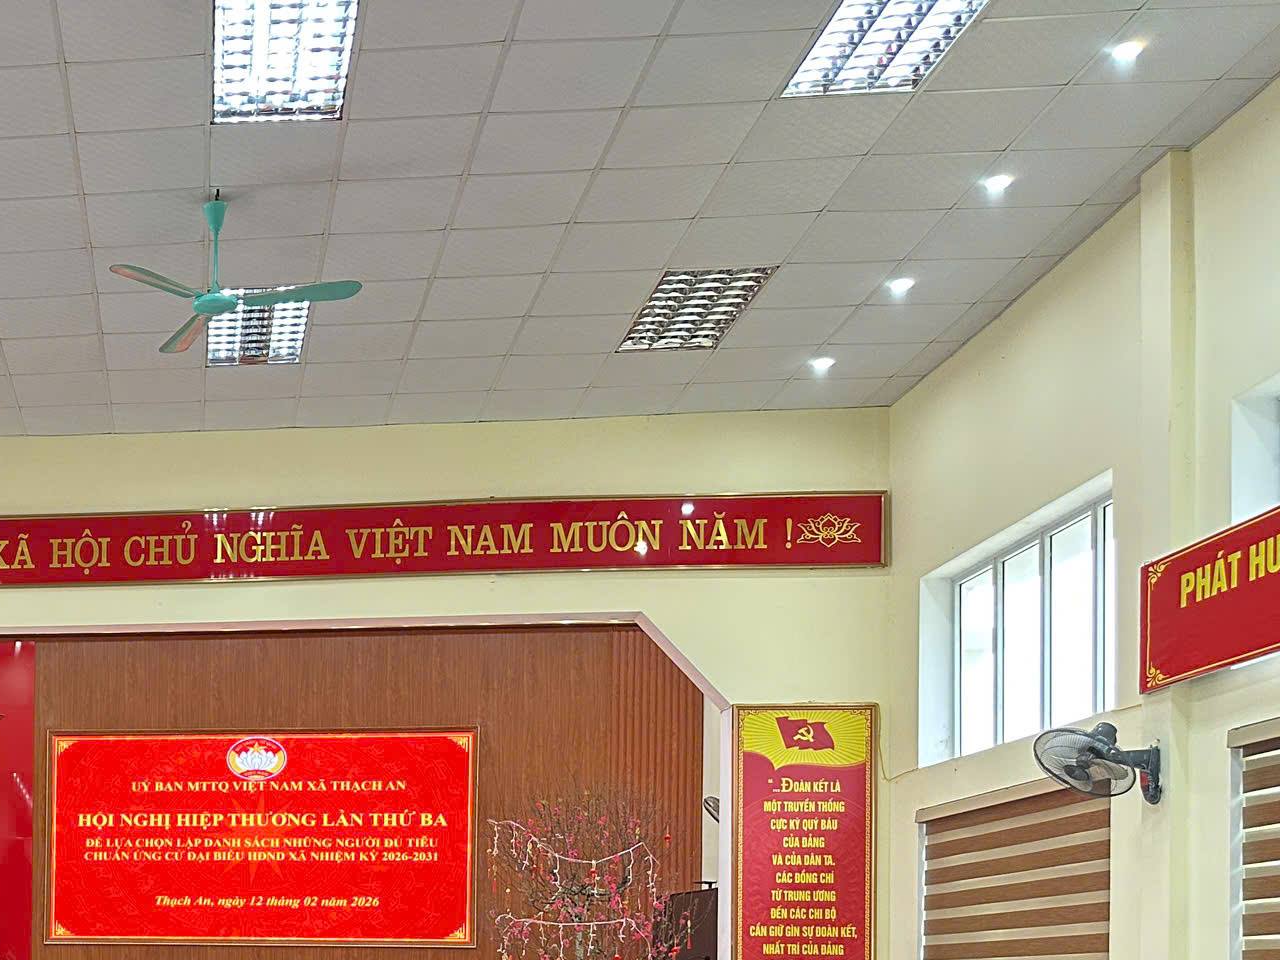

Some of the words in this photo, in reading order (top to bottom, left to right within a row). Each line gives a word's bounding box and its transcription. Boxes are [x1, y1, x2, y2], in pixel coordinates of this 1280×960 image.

[49, 529, 111, 576] HỘI
[124, 521, 199, 566] CHỦ
[213, 523, 330, 564] NGHĨA
[345, 518, 434, 566] VIỆT
[447, 523, 534, 556] NAM
[550, 512, 662, 554] MUÔN
[678, 512, 769, 552] NĂM
[1180, 549, 1241, 609] PHÁT
[155, 781, 183, 792] BAN
[187, 781, 230, 794] MTTQ
[232, 780, 266, 794] VIỆT
[271, 780, 301, 792] NAM
[307, 778, 326, 791] XÃ
[331, 780, 382, 793] THẠCH
[385, 780, 407, 791] AN
[831, 779, 841, 792] LÀ
[78, 811, 114, 831] HỘI
[120, 812, 170, 830] NGHỊ
[177, 811, 224, 830] HIỆP
[227, 811, 317, 827] THƯƠNG
[369, 808, 416, 827] THỨ
[420, 812, 448, 827] BA
[136, 837, 173, 850] CHỌN
[204, 838, 241, 848] DANH
[243, 837, 280, 848] SÁCH
[289, 850, 306, 861] XÃ
[382, 851, 439, 862] 2026-2031
[155, 895, 191, 907] Thạch
[194, 896, 215, 908] An,
[218, 896, 246, 909] ngày
[250, 896, 264, 906] 12
[266, 896, 300, 909] tháng
[304, 896, 318, 907] 02
[321, 896, 347, 907] năm
[351, 896, 380, 907] 2026
[784, 890, 811, 901] TRUNG
